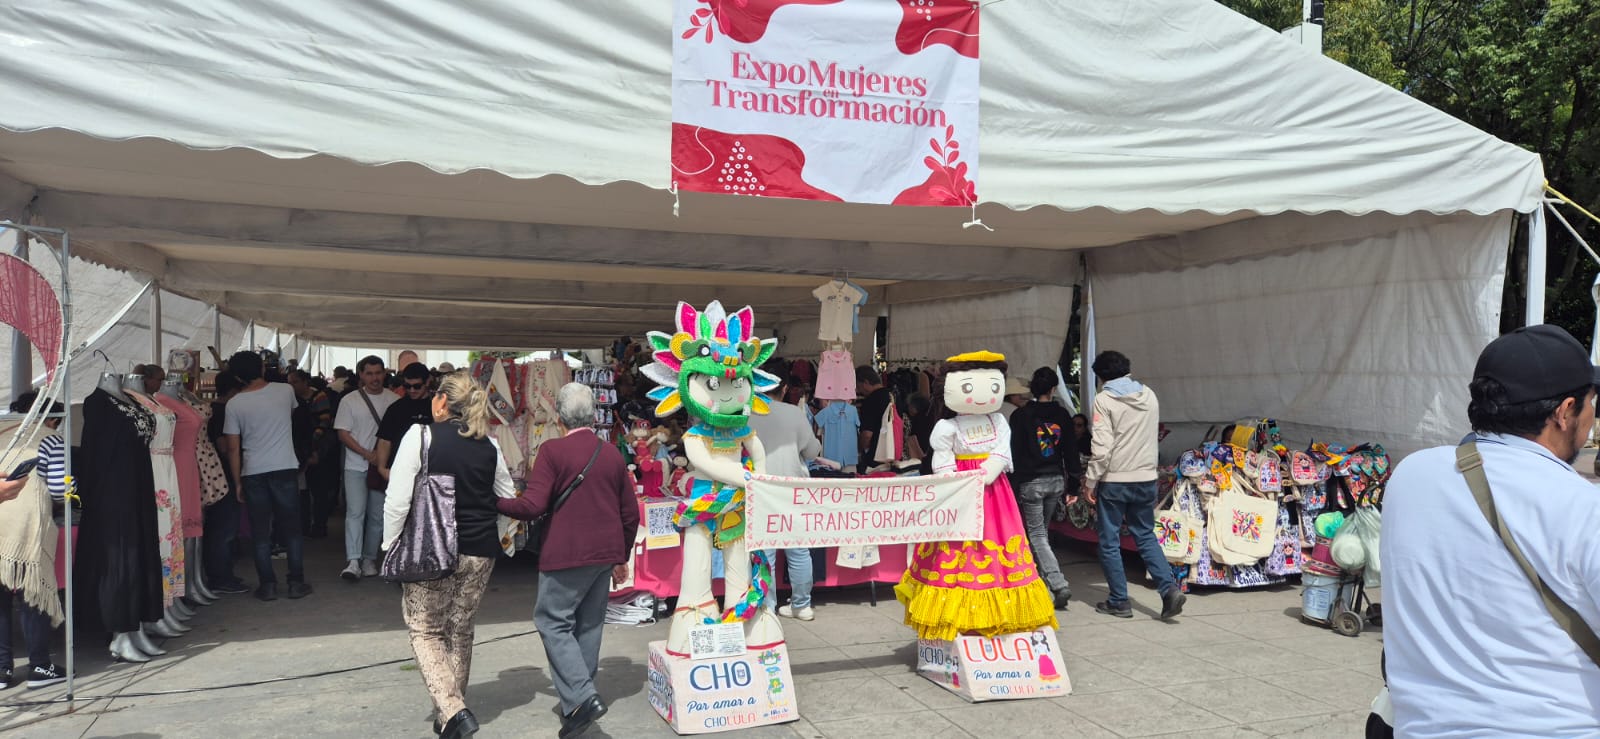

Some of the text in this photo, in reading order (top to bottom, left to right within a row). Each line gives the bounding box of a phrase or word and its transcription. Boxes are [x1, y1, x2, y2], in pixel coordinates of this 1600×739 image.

[822, 88, 840, 99] en
[706, 78, 947, 128] Transformación
[966, 424, 993, 440] LULA
[792, 484, 936, 506] EXPO-MUJERES
[766, 509, 958, 534] EN TRANSFORMACION
[963, 637, 1034, 663] LULA
[34, 666, 59, 677] DKNY
[689, 660, 752, 692] CHO
[973, 669, 1032, 680] Por amor a
[989, 685, 1035, 695] CHOLULA
[687, 696, 757, 714] Por amor a
[704, 712, 756, 729] CHOLULA
